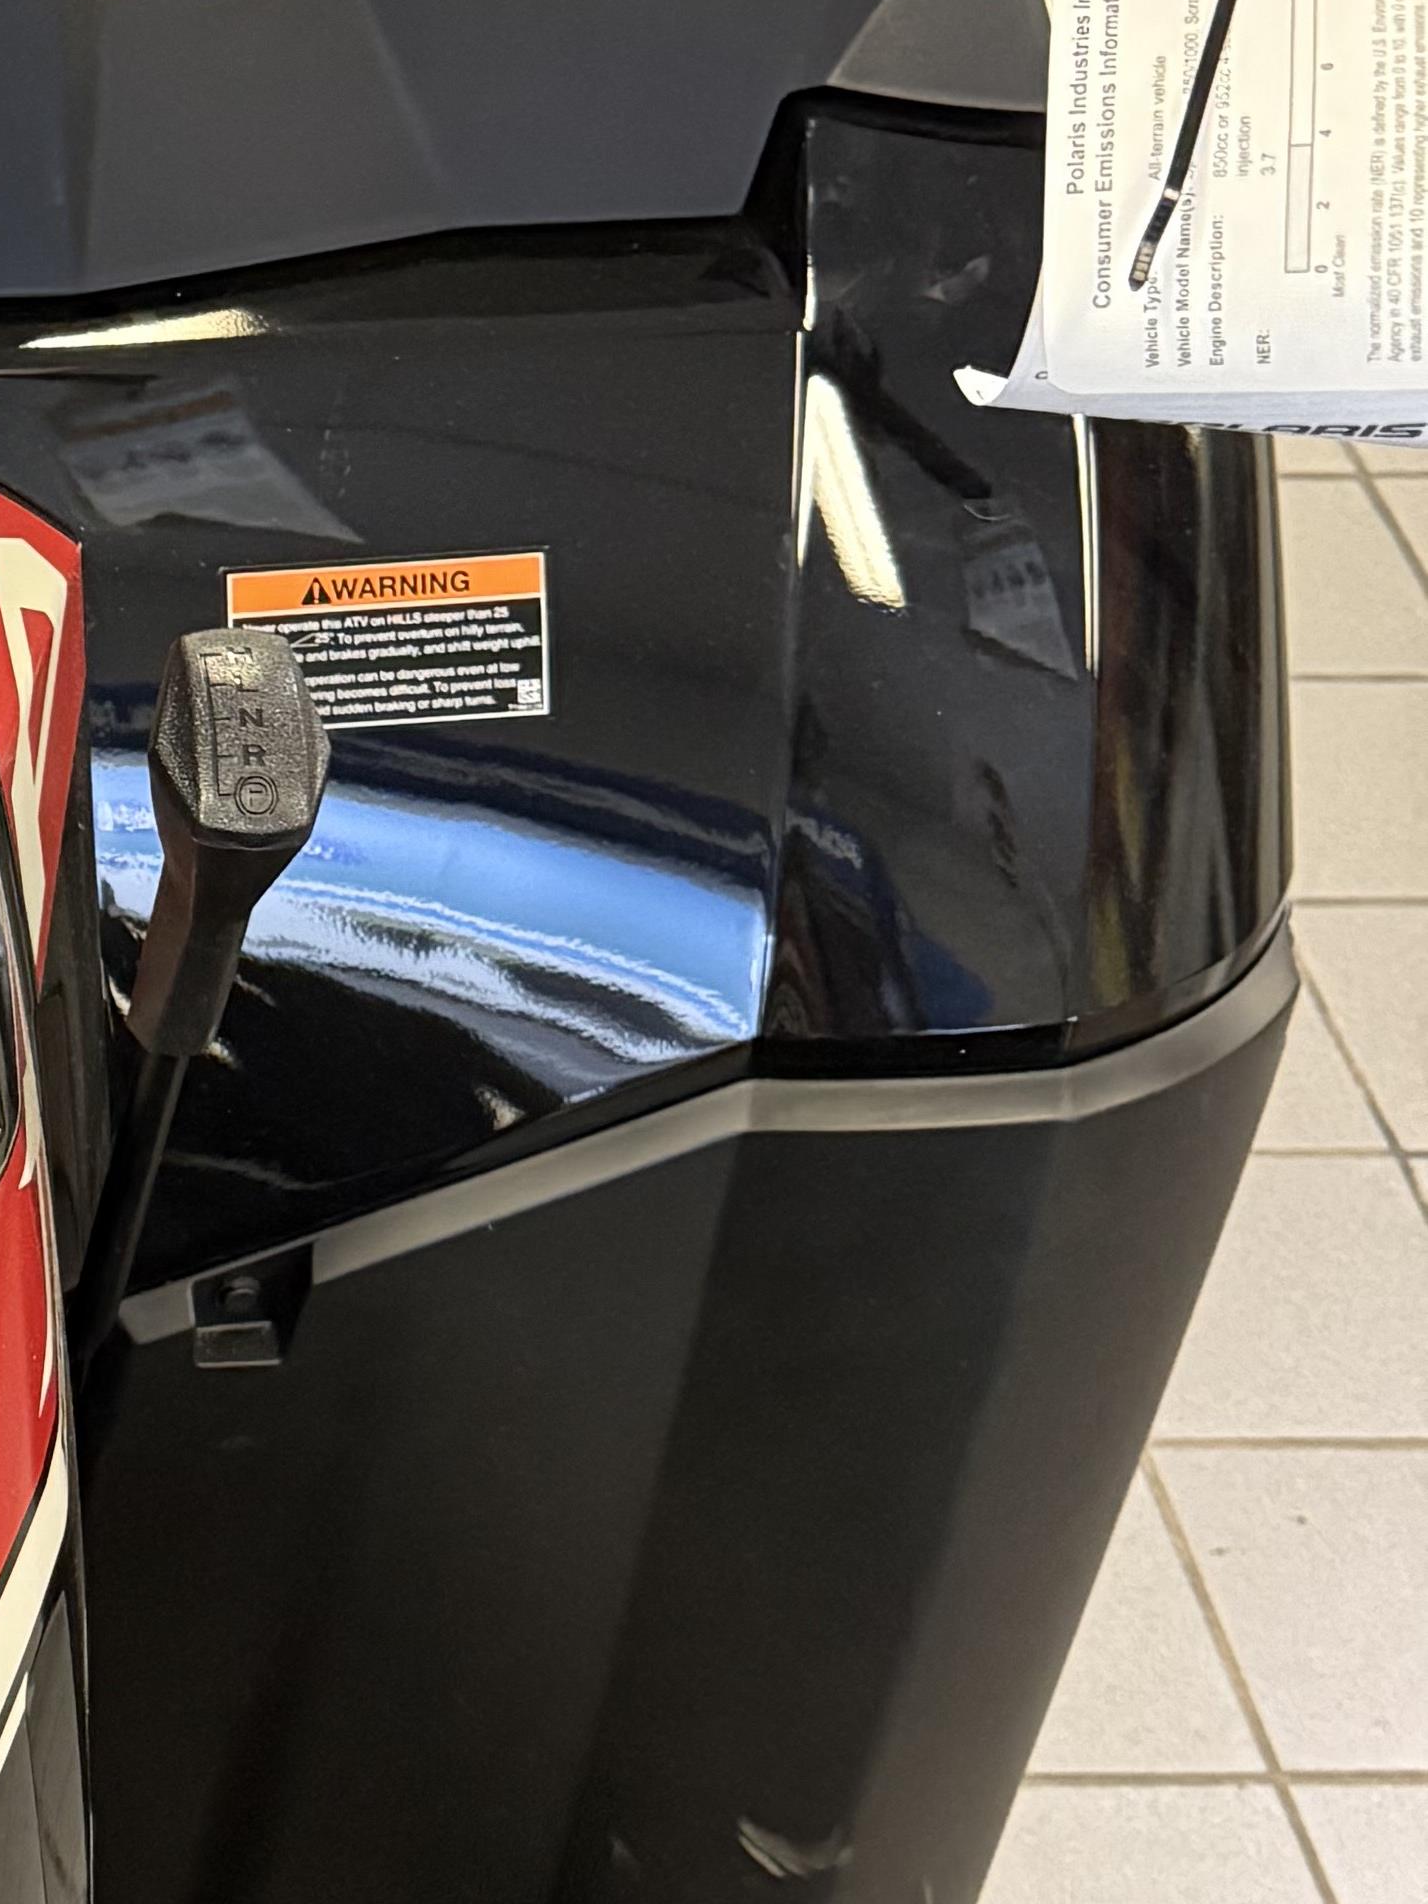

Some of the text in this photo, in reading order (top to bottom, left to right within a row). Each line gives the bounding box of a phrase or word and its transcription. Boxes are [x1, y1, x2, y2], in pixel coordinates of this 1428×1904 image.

[1068, 15, 1090, 114] Industries
[1153, 56, 1167, 105] vehicle
[1094, 83, 1115, 192] Emissions
[1148, 110, 1164, 181] All-terrain
[1217, 115, 1229, 129] or
[1236, 116, 1252, 177] injection
[1319, 129, 1332, 137] 4
[1066, 122, 1086, 195] Polaris
[1213, 133, 1228, 177] 850cc
[1316, 201, 1330, 210] 2
[1092, 200, 1112, 309] Consumer
[1208, 214, 1225, 311] Description:
[1256, 152, 1276, 364] NER: 3.7
[1314, 264, 1328, 274] 0
[1175, 263, 1190, 311] Model
[1144, 318, 1159, 367] Vehicle
[1176, 317, 1191, 367] Vehicle
[1207, 317, 1224, 366] Engine
[331, 570, 471, 600] WARNING
[344, 615, 369, 628] ATV
[239, 707, 264, 728] N
[243, 744, 267, 766] R
